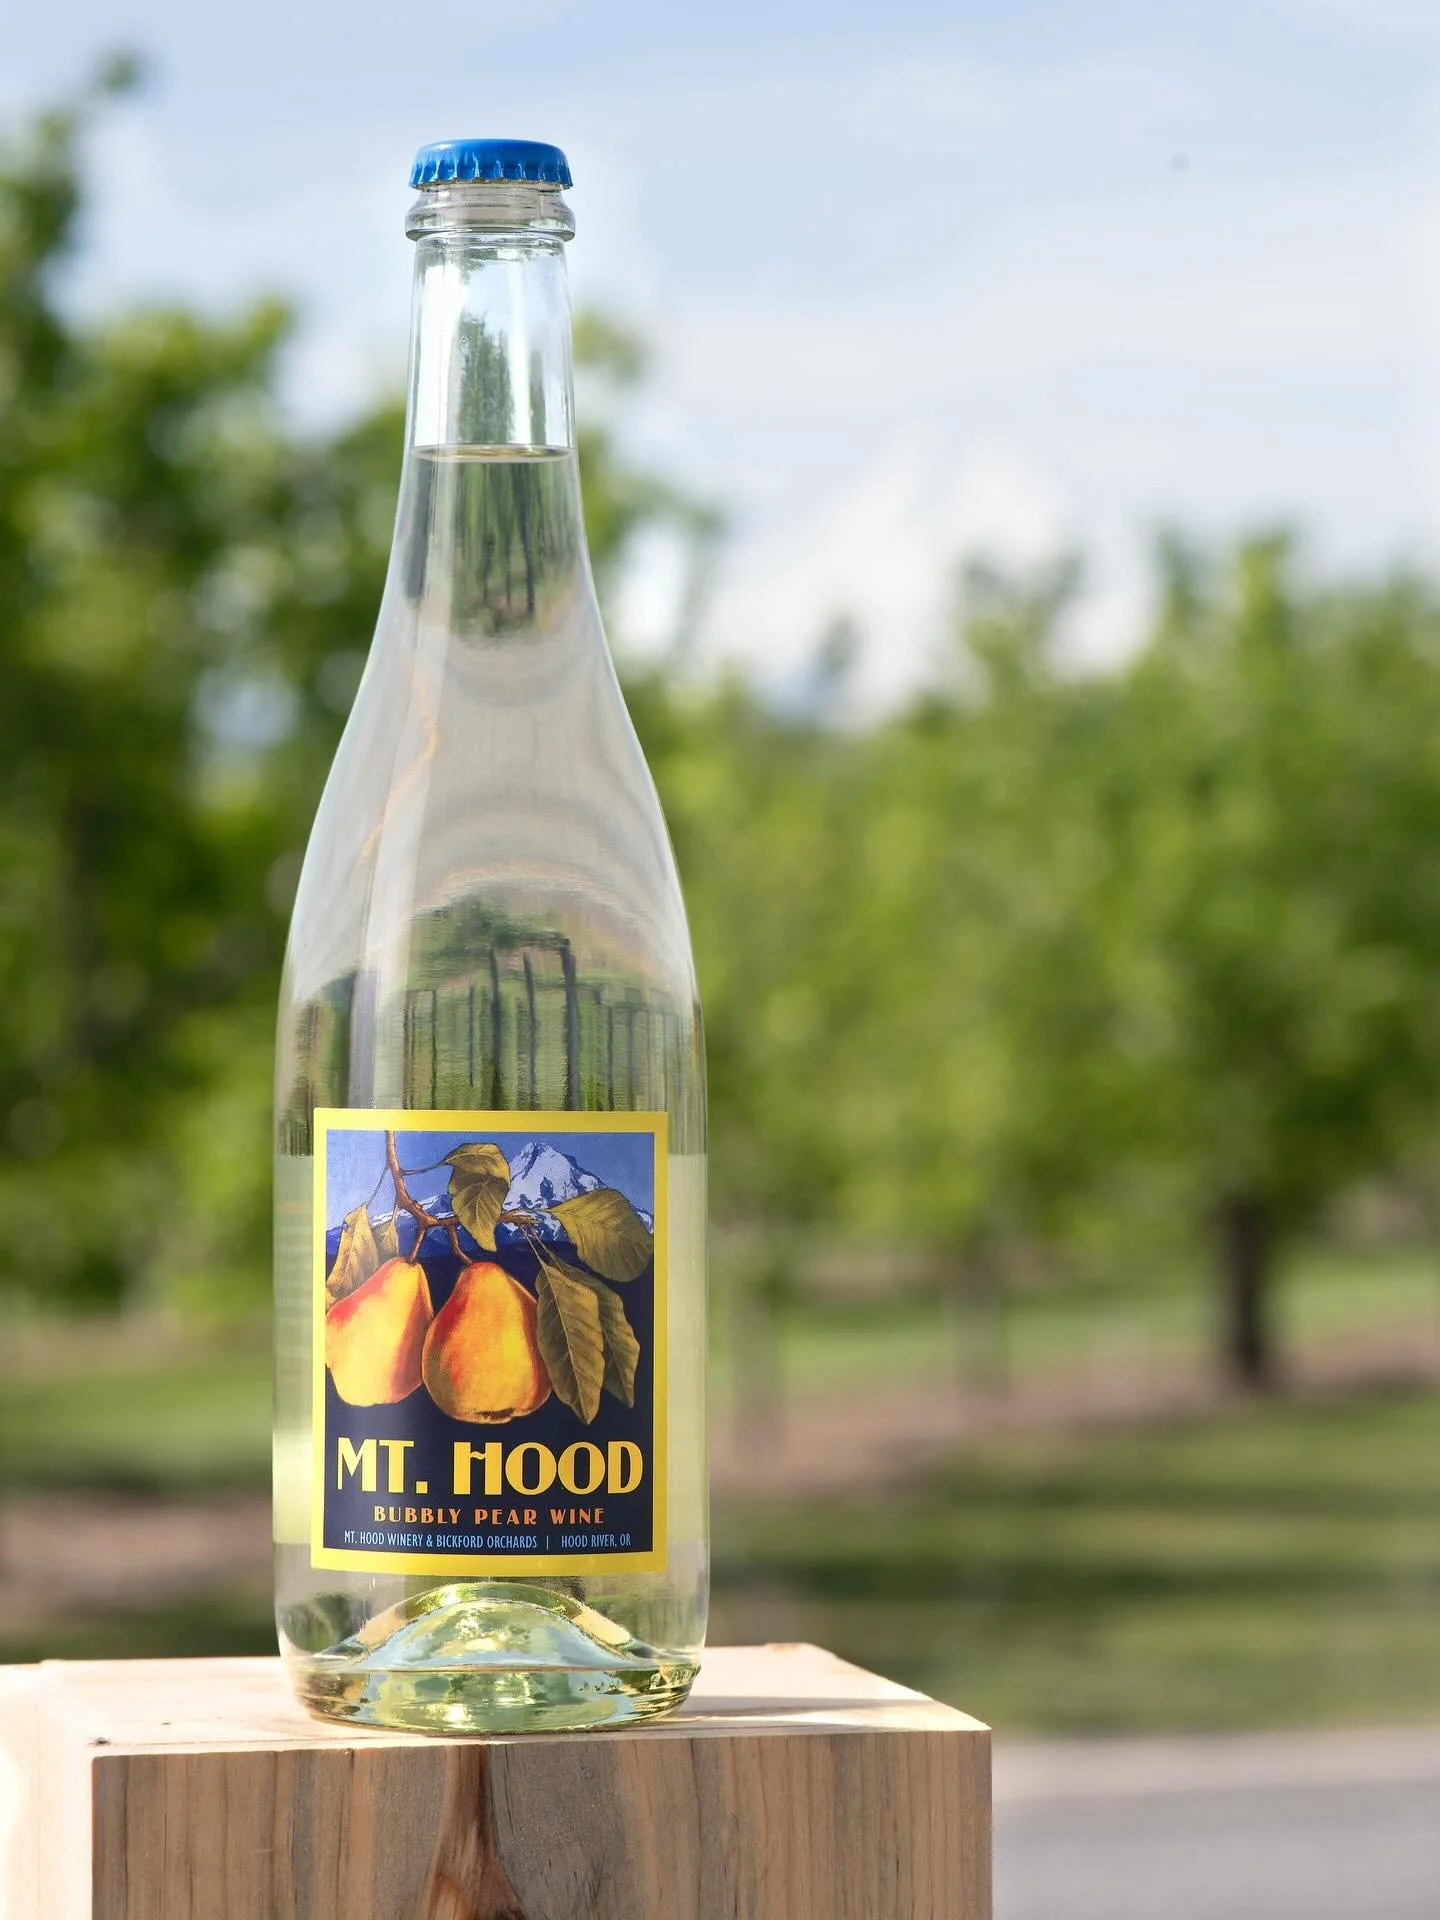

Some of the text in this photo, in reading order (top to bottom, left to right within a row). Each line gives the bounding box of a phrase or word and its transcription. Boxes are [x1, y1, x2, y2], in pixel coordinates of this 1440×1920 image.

[337, 1437, 643, 1495] MT. HOOD
[374, 1505, 604, 1526] BUBBLY PEAR WINE
[344, 1530, 631, 1549] MT. HOOD WINERY & BICKFORD ORCHARDS HOOD RIVER, OR
